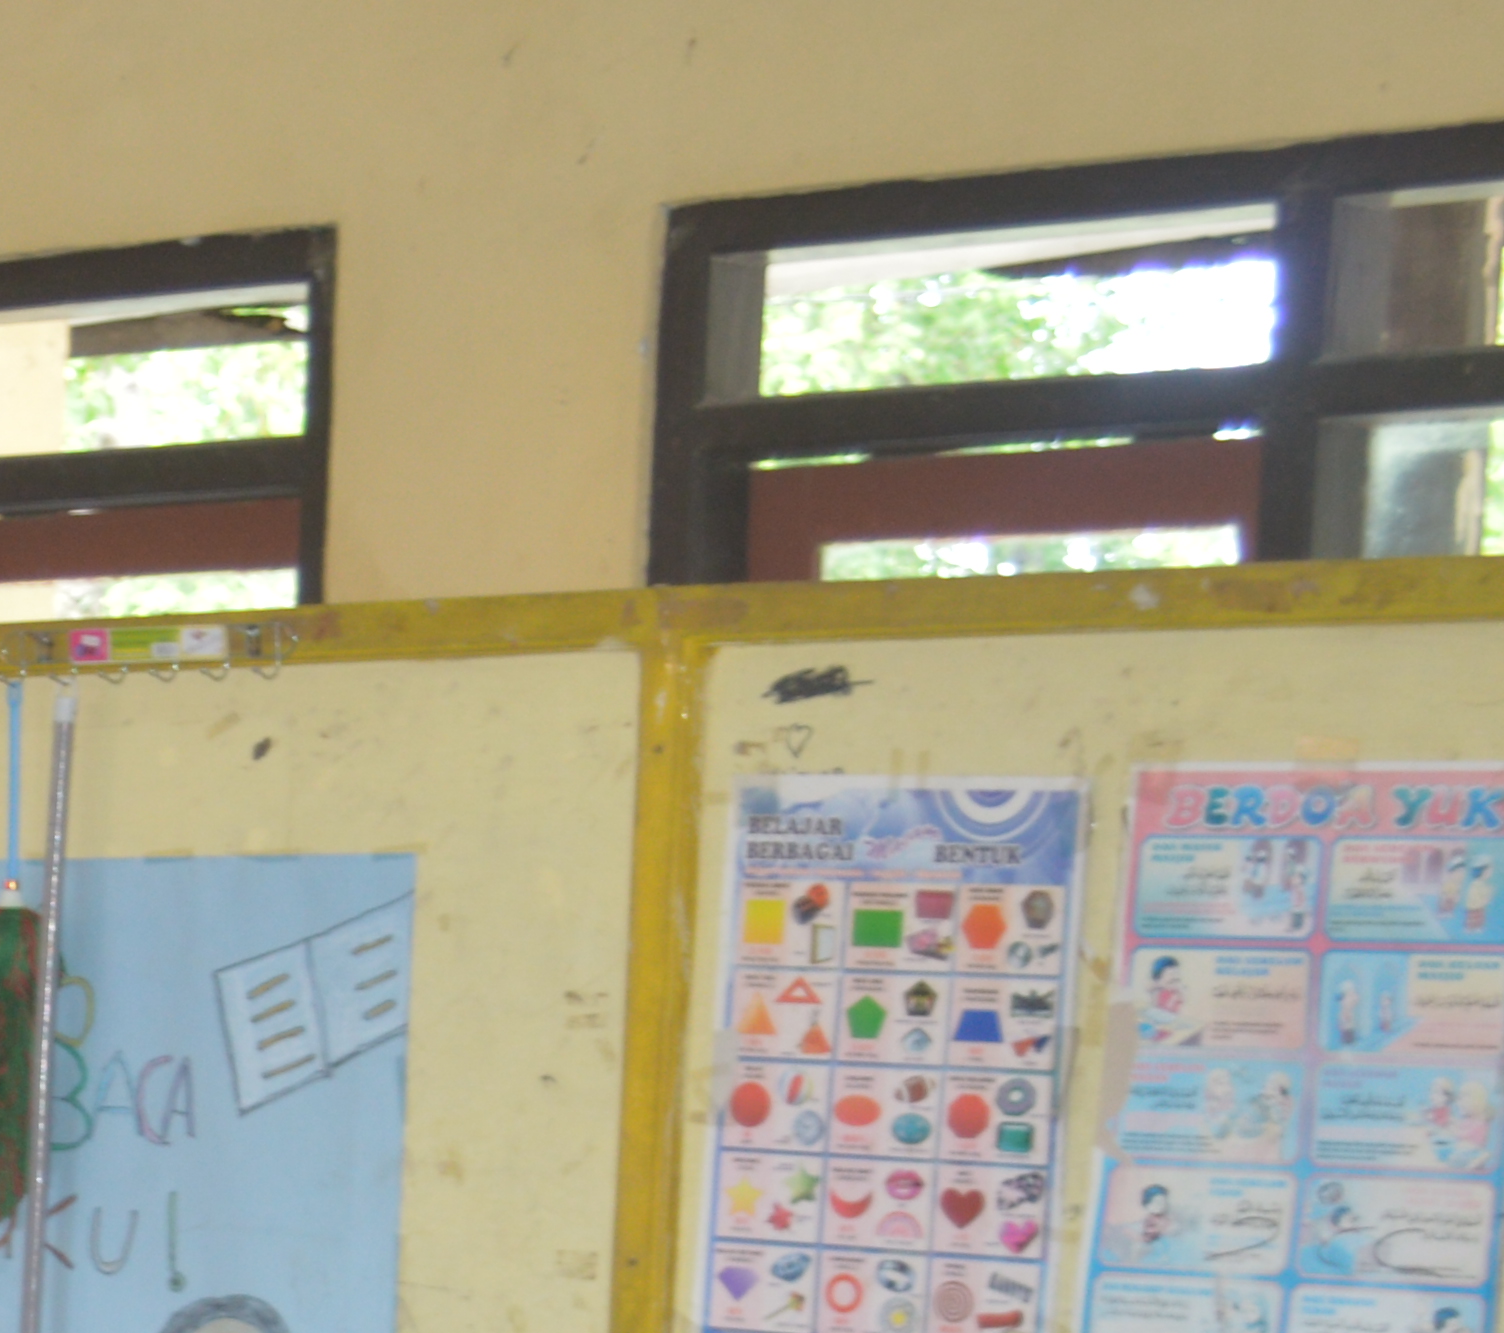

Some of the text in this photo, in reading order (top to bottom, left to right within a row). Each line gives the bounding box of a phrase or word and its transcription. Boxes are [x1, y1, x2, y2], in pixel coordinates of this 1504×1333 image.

[1165, 783, 1504, 830] BERDOA YUK
[746, 815, 843, 837] BELAJAR
[746, 840, 855, 862] BERBAGAI
[934, 844, 1022, 865] BENTUK
